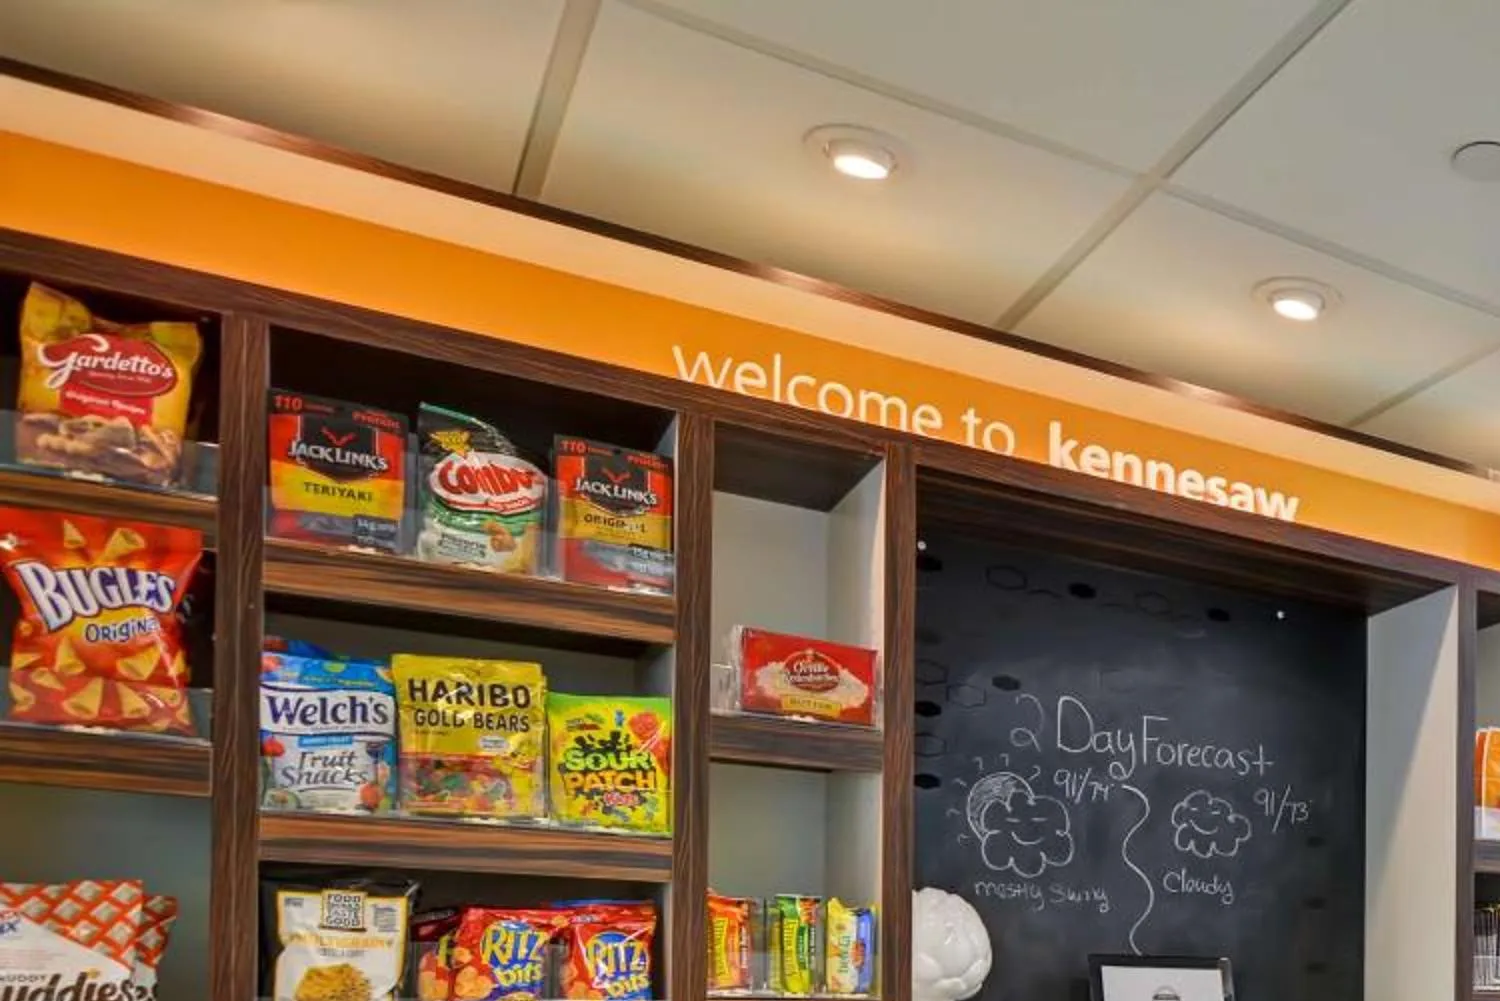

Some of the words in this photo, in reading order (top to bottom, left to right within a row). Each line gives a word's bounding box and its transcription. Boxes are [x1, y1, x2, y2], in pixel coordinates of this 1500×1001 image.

[672, 345, 943, 437] welcome
[961, 407, 1016, 456] to
[1049, 420, 1300, 522] kennesaw
[288, 442, 335, 463] JACK
[303, 481, 374, 503] TERIYAKI
[574, 476, 612, 498] JACK
[14, 561, 177, 633] BUGLES
[407, 677, 532, 709] HARIBO
[266, 695, 390, 727] Welch's
[414, 708, 466, 730] GOLD
[473, 711, 531, 733] BEARS
[1057, 695, 1138, 781] Day
[1142, 715, 1275, 777] Forecast
[298, 750, 360, 771] Fruit
[563, 748, 653, 771] SOUR
[281, 765, 369, 787] Snacks
[563, 769, 657, 799] PATCH
[1162, 868, 1234, 905] Cloudy
[481, 925, 551, 967] RITZ
[584, 938, 648, 980] RITZ
